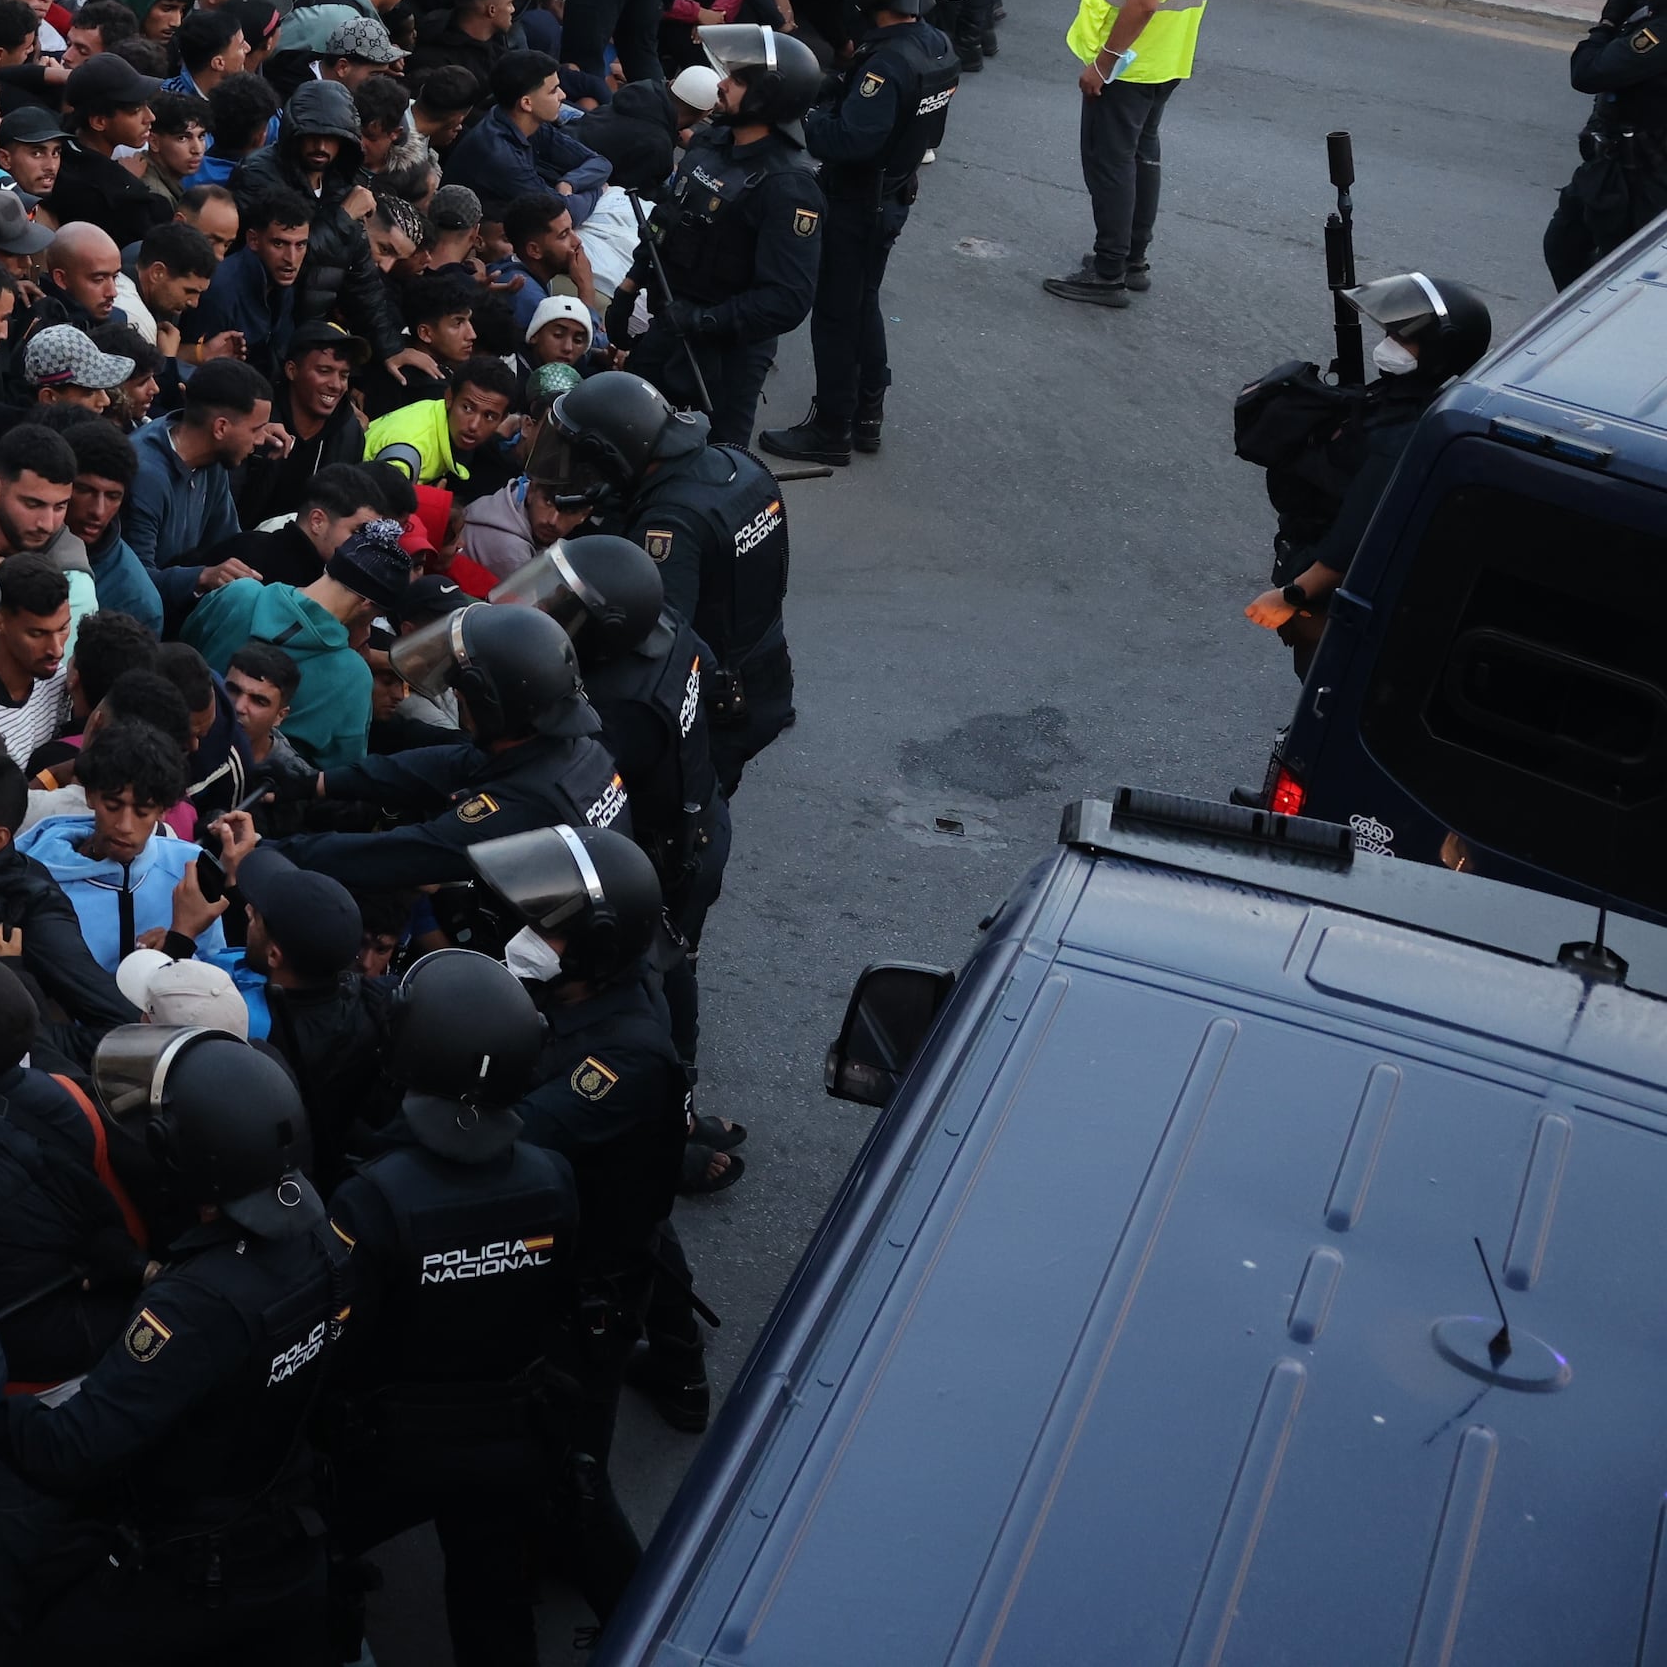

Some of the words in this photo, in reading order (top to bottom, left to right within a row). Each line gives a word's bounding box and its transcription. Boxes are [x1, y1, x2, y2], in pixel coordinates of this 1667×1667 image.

[734, 507, 772, 546] POLICIA
[736, 516, 783, 558] NACIONAL
[420, 1252, 553, 1285] NACIONAL
[422, 1241, 526, 1270] POLICIA
[271, 1321, 329, 1374] POLICI
